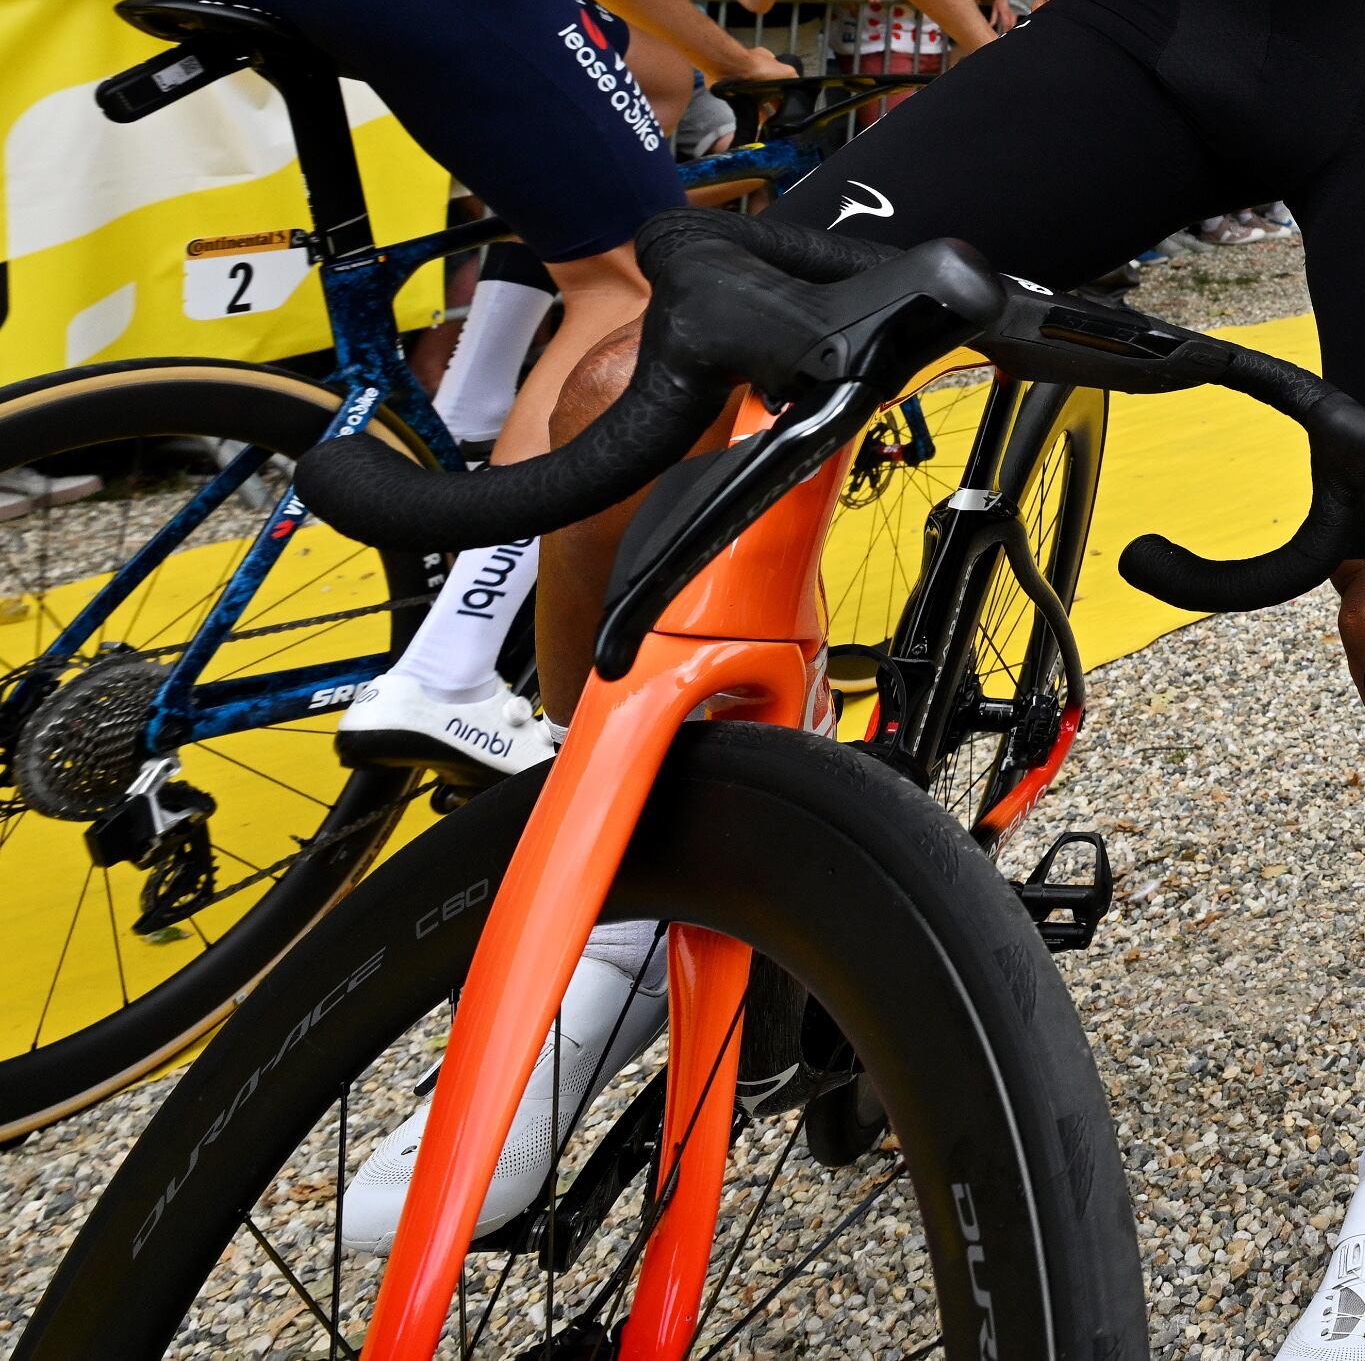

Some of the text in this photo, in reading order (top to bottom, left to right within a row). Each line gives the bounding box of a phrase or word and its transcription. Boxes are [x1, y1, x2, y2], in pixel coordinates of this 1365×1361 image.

[187, 231, 274, 256] Continental
[225, 261, 254, 314] 2
[446, 718, 514, 757] nimbl
[132, 945, 387, 1260] DURA-ACE
